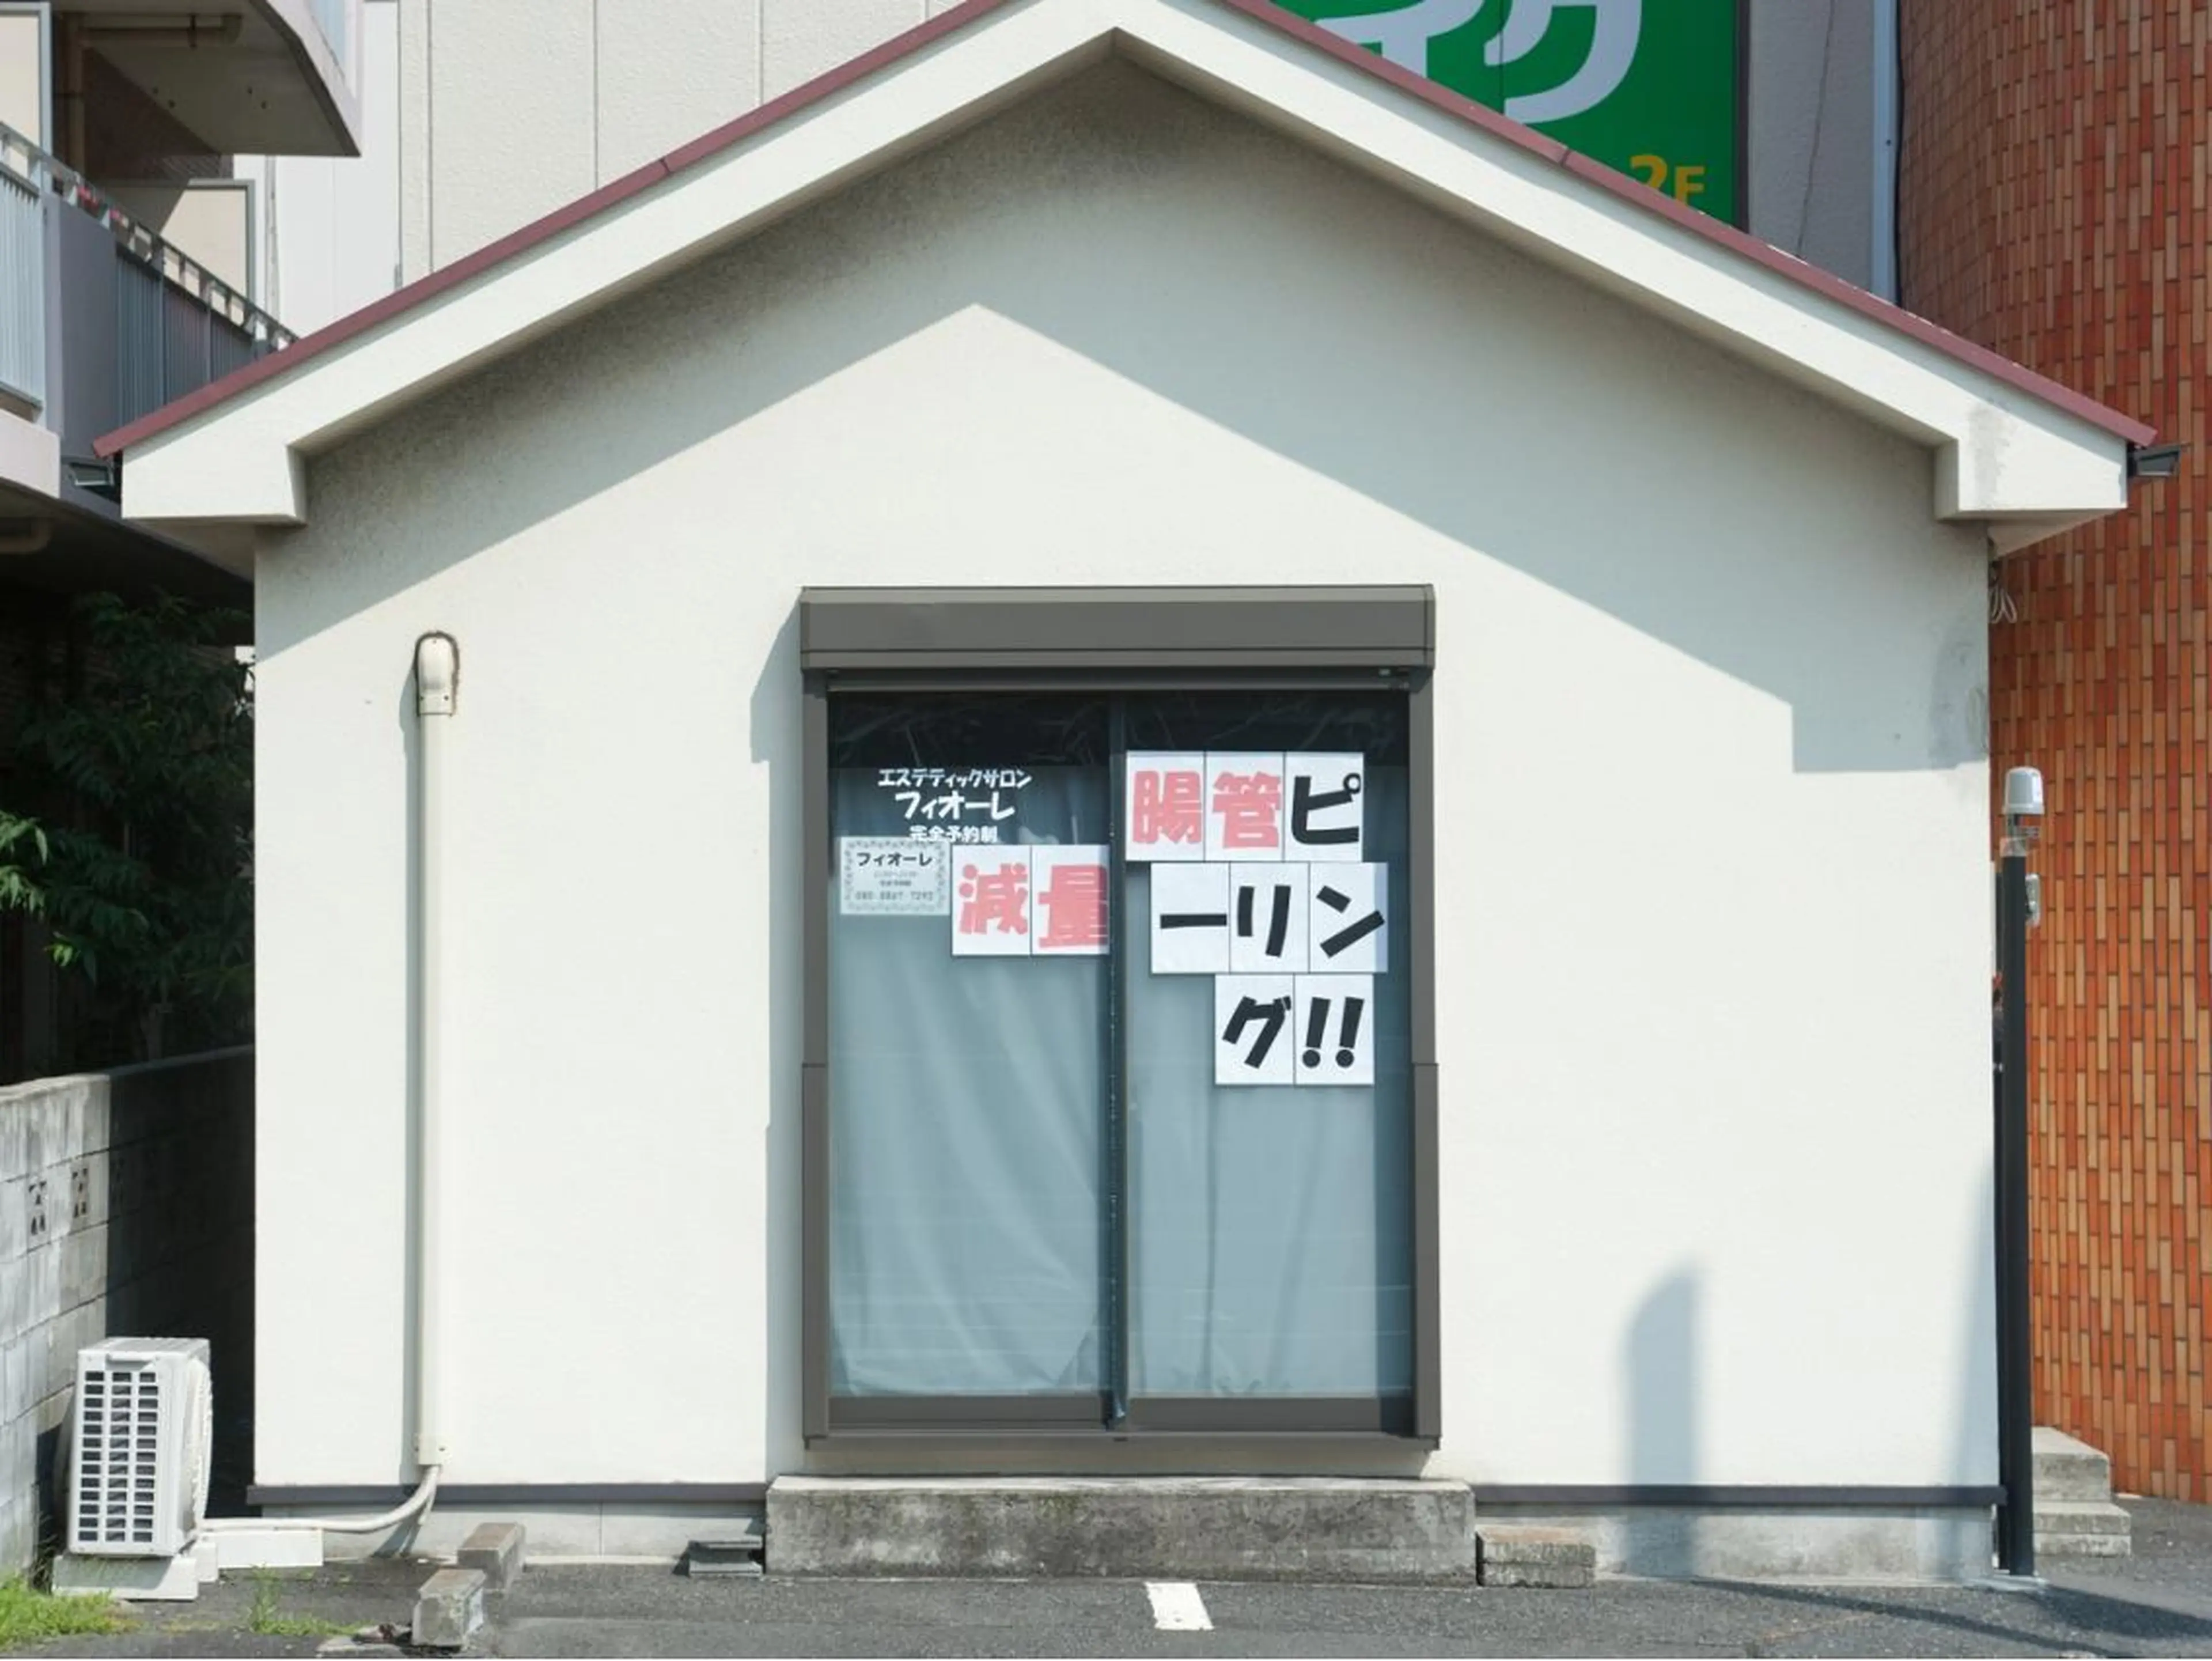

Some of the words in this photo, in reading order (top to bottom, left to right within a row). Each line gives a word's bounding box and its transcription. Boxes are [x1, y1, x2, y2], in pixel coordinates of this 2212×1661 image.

[1631, 154, 1705, 205] 2F
[877, 767, 1032, 788] エステティックサロン
[895, 790, 1015, 820] フィオーレ
[908, 825, 998, 843] 完全予約制
[857, 852, 933, 867] フィオーレ
[959, 862, 1108, 948] 減量
